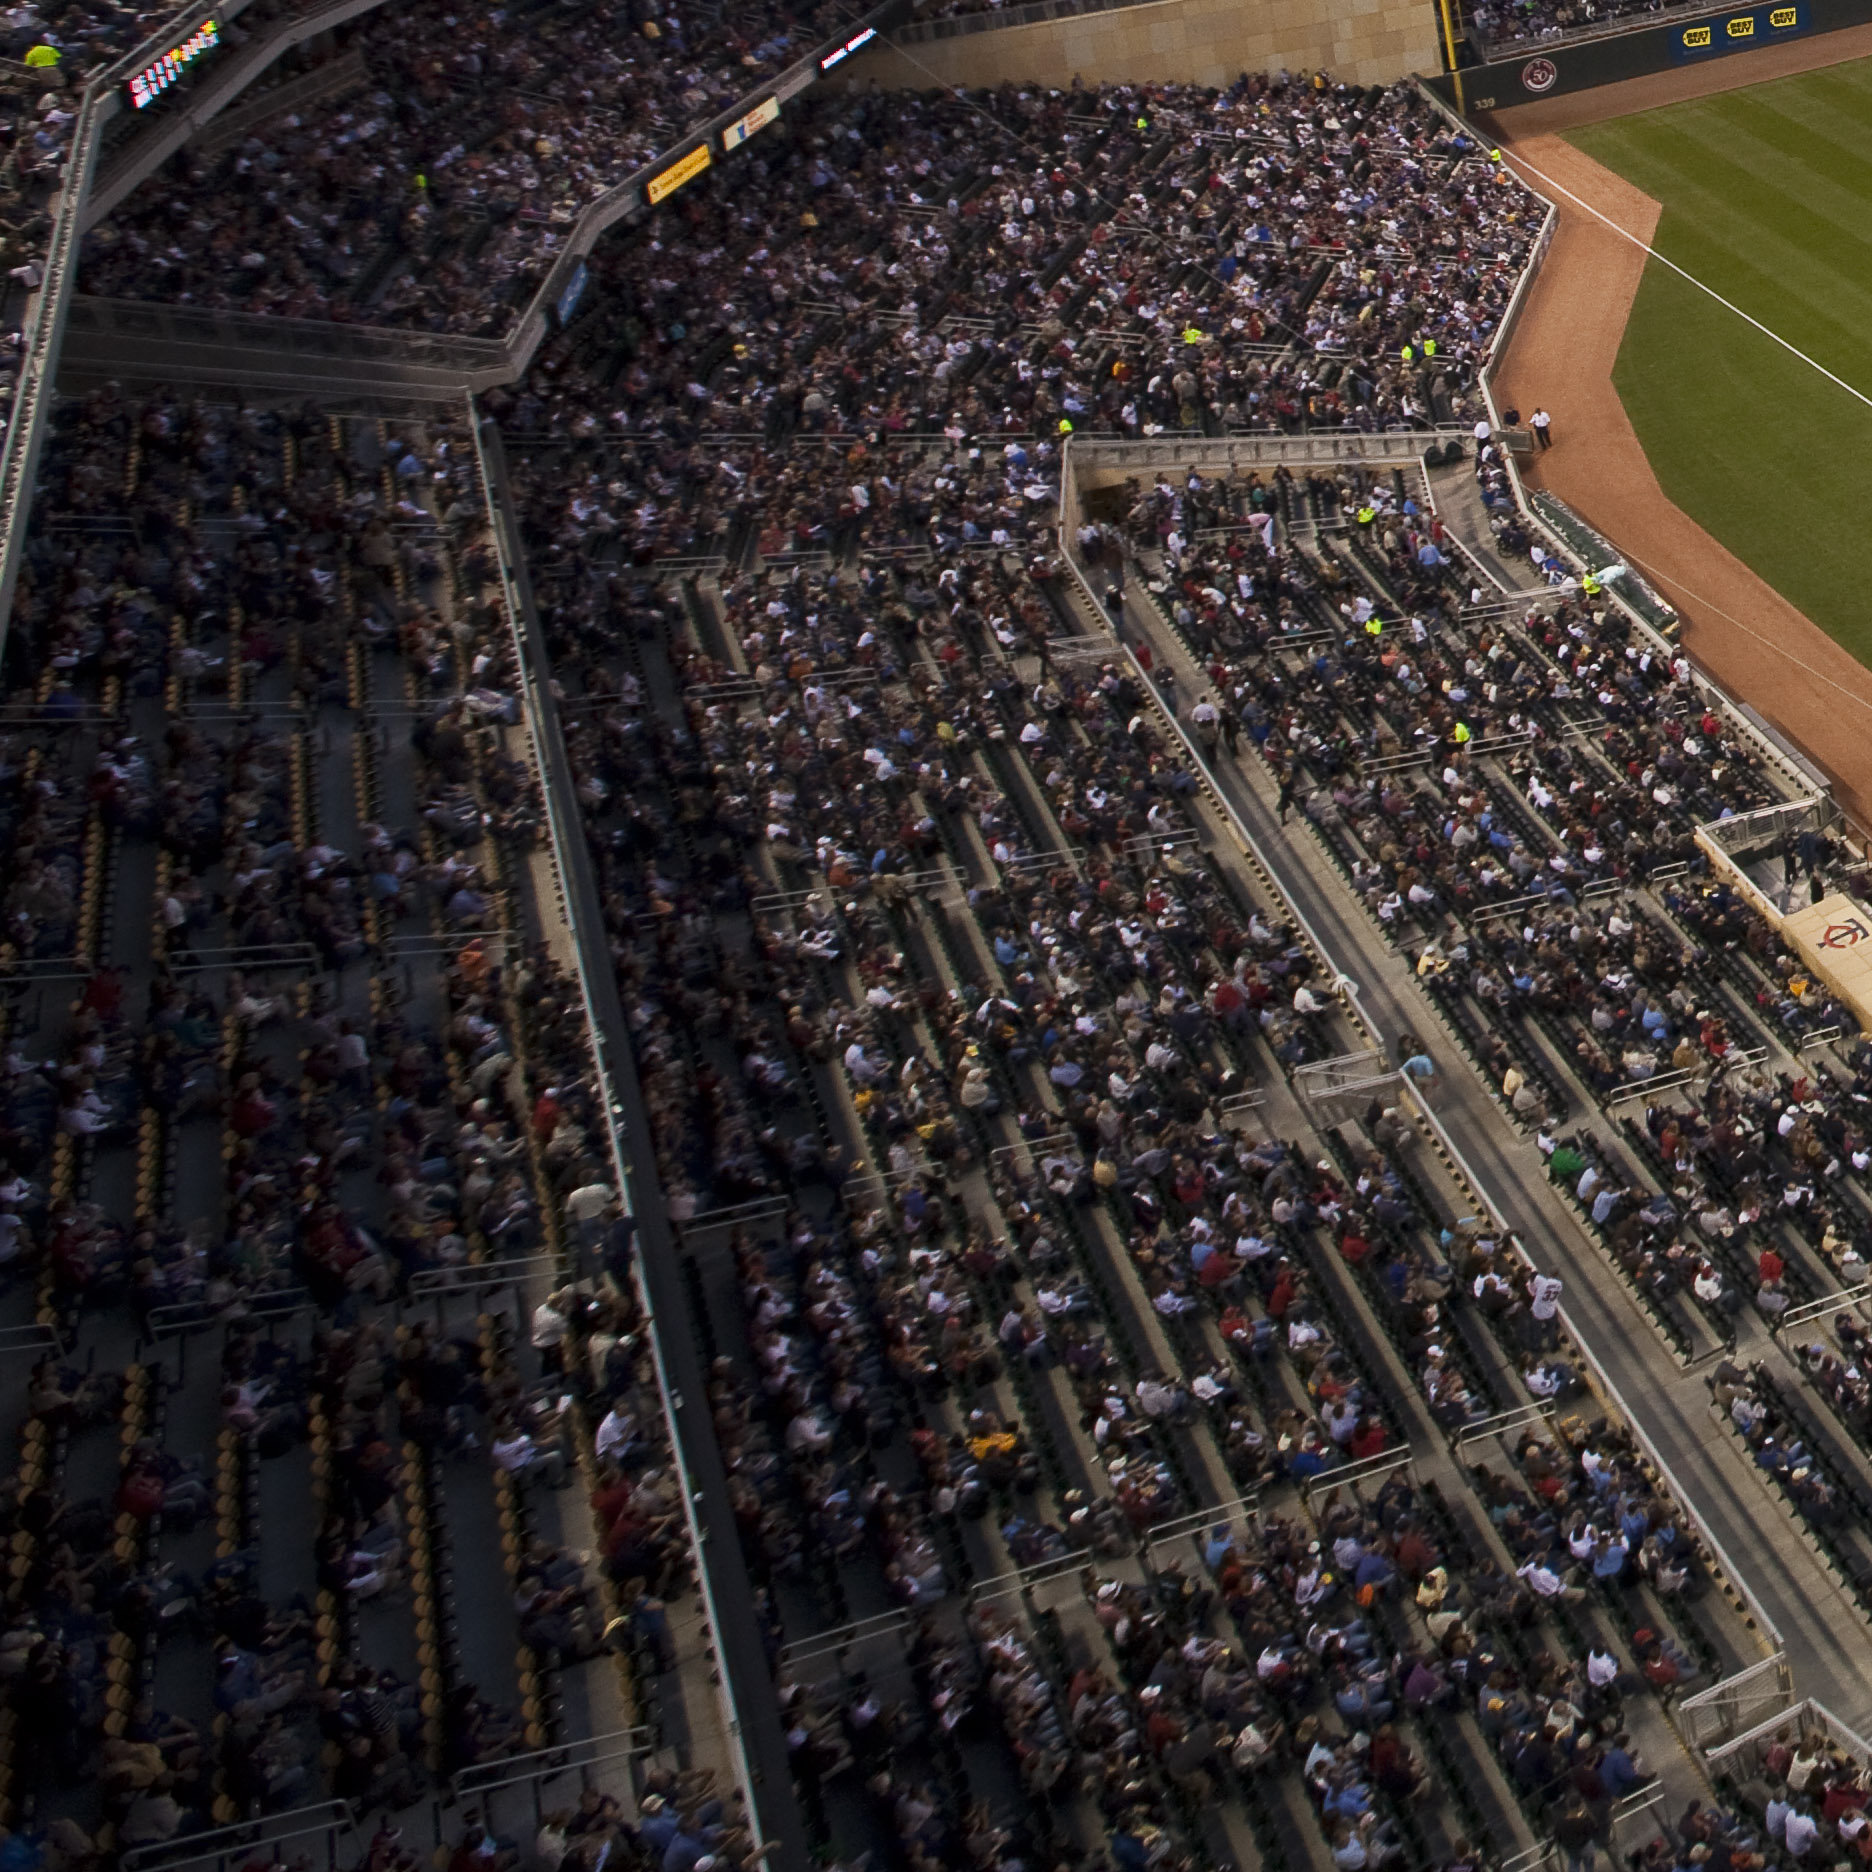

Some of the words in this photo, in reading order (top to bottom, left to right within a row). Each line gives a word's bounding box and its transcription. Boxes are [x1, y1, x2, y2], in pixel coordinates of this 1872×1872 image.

[1773, 11, 1795, 19] BEST
[1730, 20, 1753, 29] BEST
[1774, 17, 1793, 25] BUY
[1687, 30, 1709, 39] BEST
[1731, 26, 1750, 35] BUY
[1687, 36, 1707, 44] BUY
